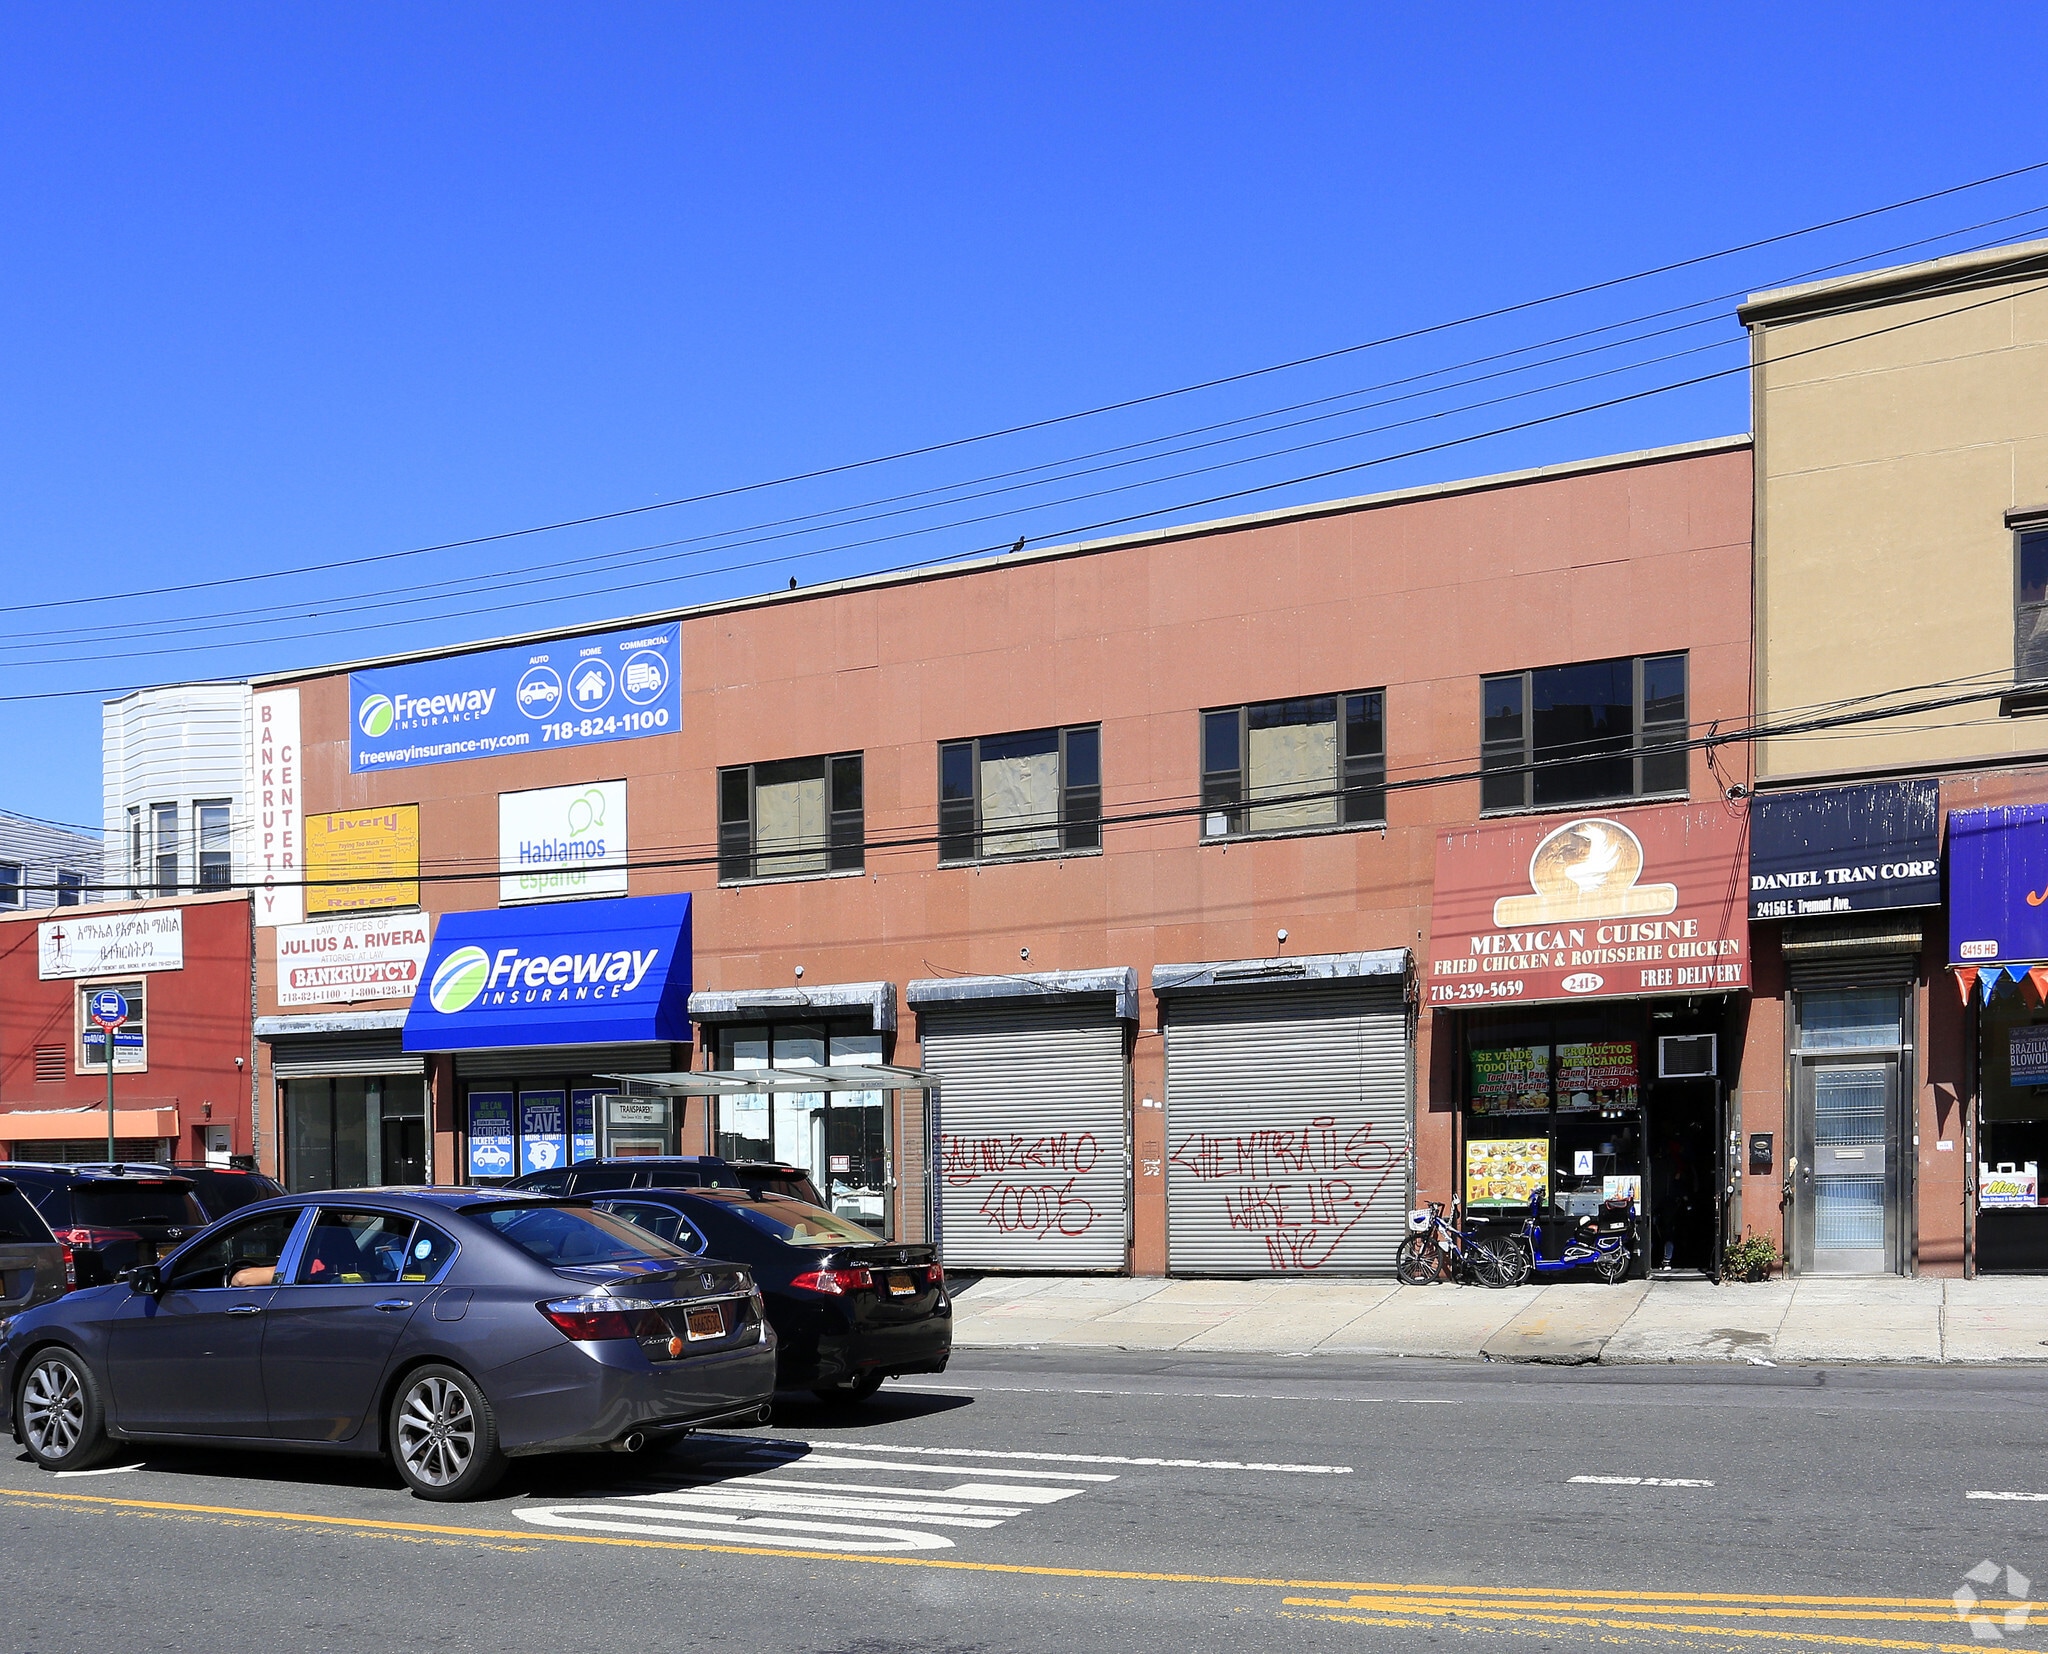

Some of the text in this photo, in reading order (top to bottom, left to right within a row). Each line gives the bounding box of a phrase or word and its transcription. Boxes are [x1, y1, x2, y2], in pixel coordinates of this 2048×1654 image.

[580, 647, 602, 657] HOME
[619, 636, 669, 651] COMMERCIAL
[529, 655, 549, 665] AUTO
[395, 687, 496, 721] Freeway
[395, 711, 480, 731] INSURANCE
[541, 708, 669, 743] 718-824-1100
[359, 731, 530, 765] freewayinsurance-ny.com
[262, 705, 275, 913] BANKRUPTCY
[281, 745, 293, 869] CENTER
[327, 813, 397, 833] Livery
[520, 838, 606, 864] Hablamos
[520, 861, 586, 893] español
[1751, 861, 1937, 891] DANIEL TRAN CORP.
[328, 896, 397, 907] Rates
[1788, 901, 1796, 915] E.
[1798, 898, 1832, 914] Tremont
[1833, 897, 1852, 911] Ave.
[316, 919, 389, 935] LAW OFFICES OF
[282, 929, 426, 956] JULIUS A. RIVERA
[1470, 918, 1699, 956] MEXICAN CUISINE
[321, 951, 384, 963] ATTORNEY AT LAW
[1434, 939, 1740, 976] FRIED CHICKEN & ROTISSERIE CHICKEN
[1962, 944, 1996, 956] 2415 HE
[295, 960, 412, 987] BANKRUPTCY
[488, 948, 659, 992] Freeway
[1640, 964, 1743, 988] FREE DELIVERY
[1431, 980, 1524, 1001] 718-239-5659
[1569, 976, 1598, 991] 2415
[282, 990, 341, 1003] 718-824-1100
[482, 984, 621, 1006] INSURANCE
[1478, 1050, 1533, 1062] SE VENDE
[1563, 1044, 1632, 1057] PRODUCTOS
[2010, 1041, 2048, 1055] BRAZILIA
[1476, 1056, 1549, 1073] TODO TIPO de
[1562, 1055, 1633, 1068] MEXICANOS
[1558, 1069, 1586, 1078] Carne
[1558, 1078, 1620, 1088] Queso Fresco
[620, 1105, 654, 1114] TRANSPARENT
[472, 1126, 511, 1137] ACCIDENTS
[525, 1113, 561, 1133] SAVE
[472, 1137, 495, 1145] TICKETS
[525, 1133, 562, 1142] MORE TODAY!
[1578, 1154, 1589, 1169] A
